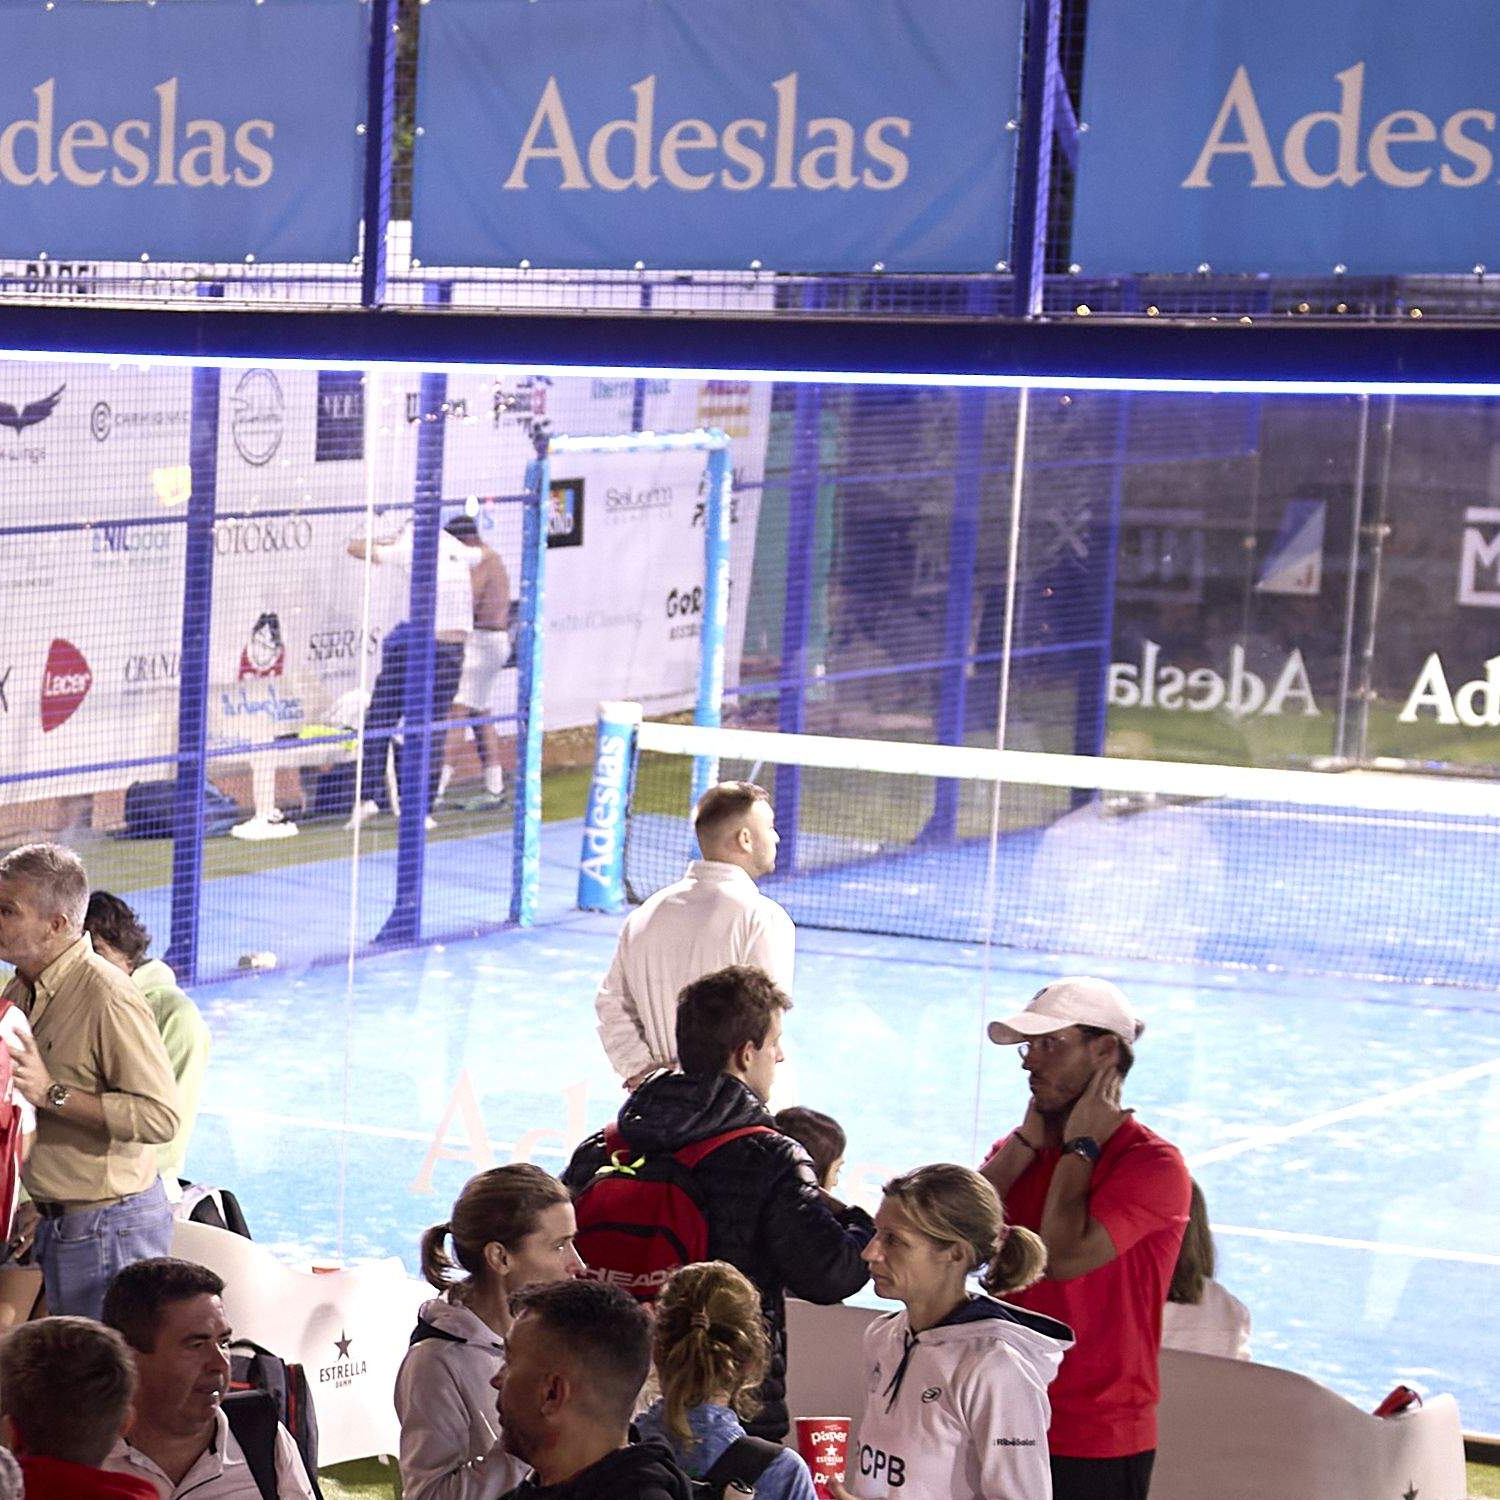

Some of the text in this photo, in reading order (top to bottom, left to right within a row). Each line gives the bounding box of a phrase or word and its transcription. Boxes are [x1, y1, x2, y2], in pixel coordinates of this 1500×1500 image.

[503, 71, 912, 193] Adeslas
[1181, 61, 1500, 191] Ades
[45, 670, 91, 697] Lacer
[581, 733, 627, 888] Adeslas
[586, 1266, 667, 1288] HEAD
[319, 1360, 367, 1382] ESTRELLA
[857, 1440, 906, 1488] CPB
